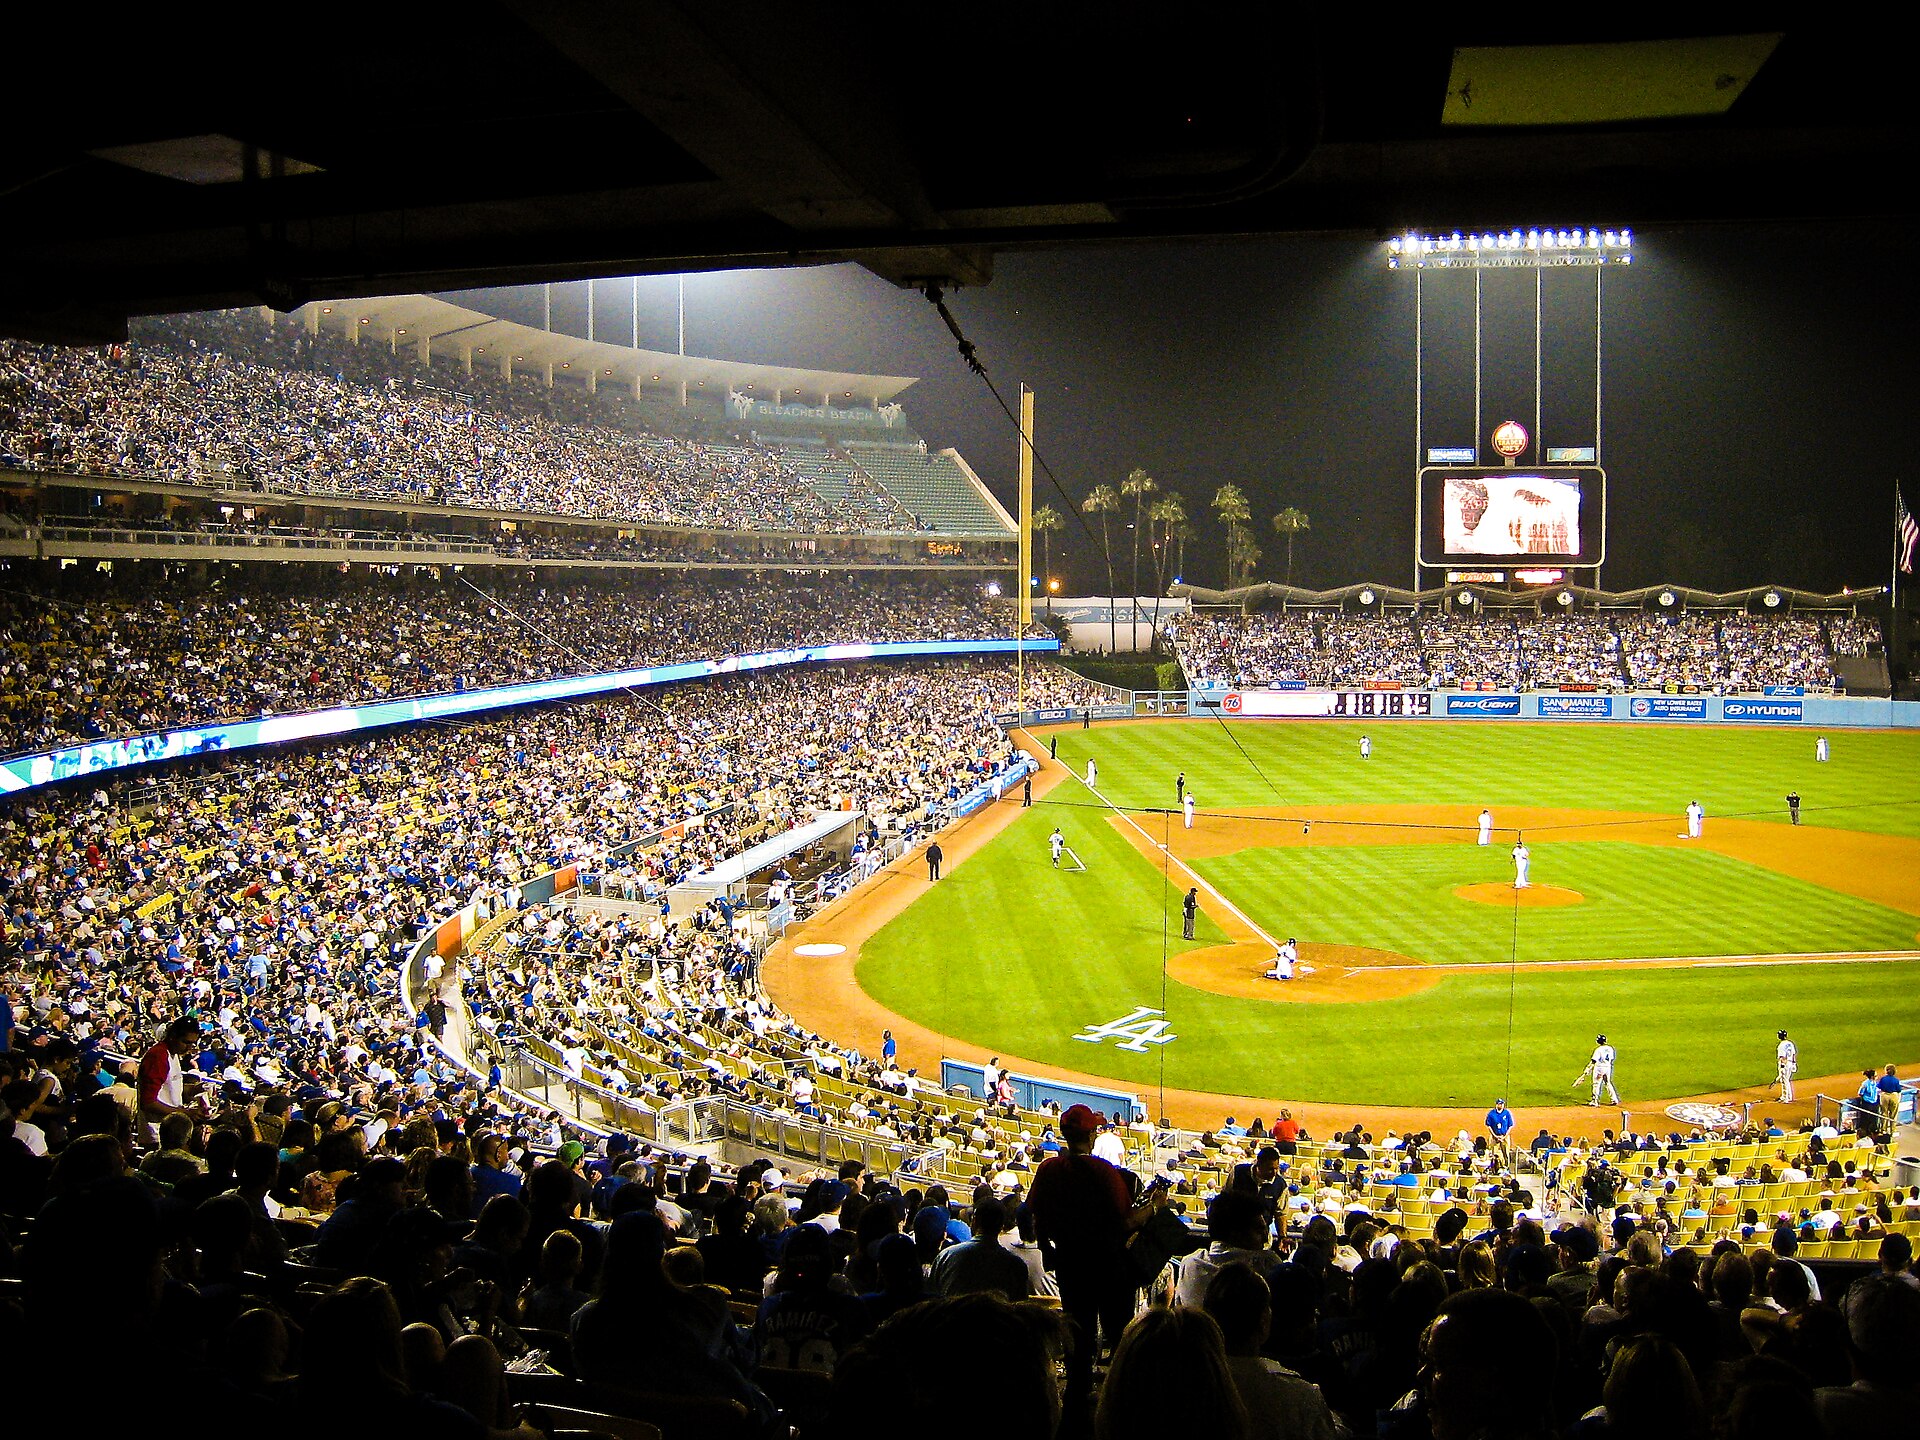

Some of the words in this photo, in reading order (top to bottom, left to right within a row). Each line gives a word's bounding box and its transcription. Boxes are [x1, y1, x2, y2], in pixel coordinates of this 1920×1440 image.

[759, 406, 824, 418] BLEACHER
[830, 409, 873, 420] BEACH
[1449, 700, 1477, 708] BUD
[1543, 697, 1562, 706] SAN
[1569, 698, 1608, 707] MANUEL
[1039, 710, 1067, 719] GEICO
[1747, 705, 1801, 716] HYUNDAI
[1071, 1004, 1178, 1053] LA
[765, 1310, 841, 1338] RAMIREZ
